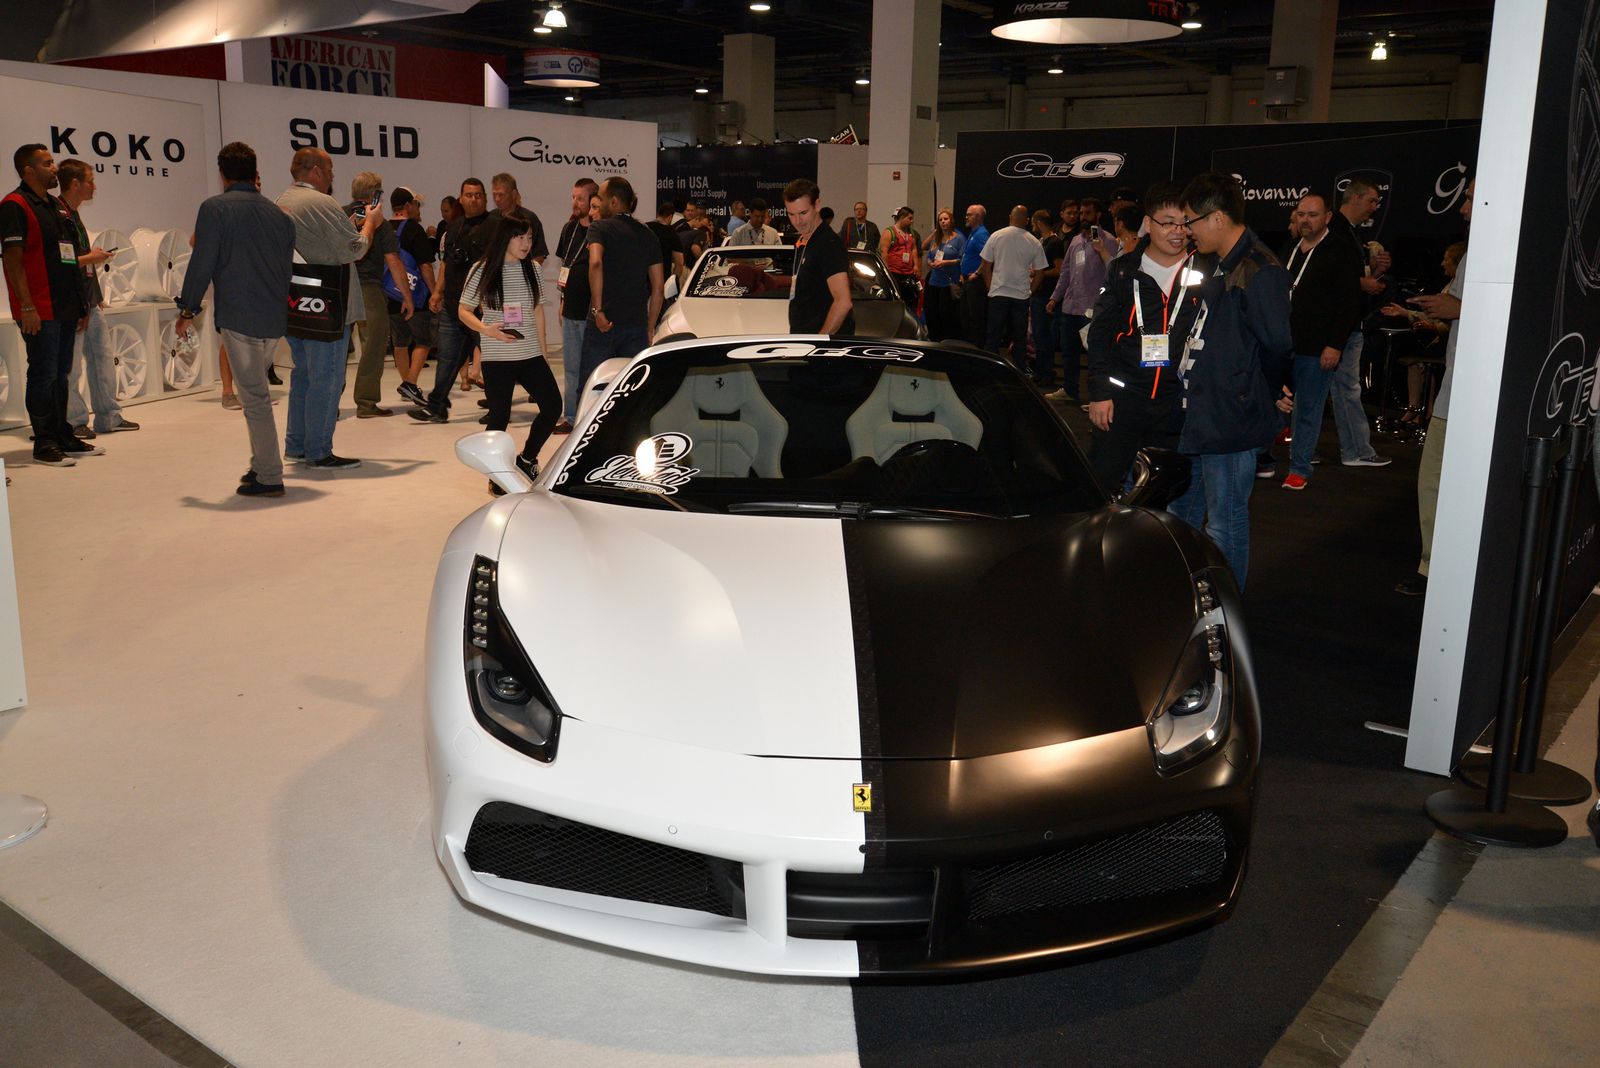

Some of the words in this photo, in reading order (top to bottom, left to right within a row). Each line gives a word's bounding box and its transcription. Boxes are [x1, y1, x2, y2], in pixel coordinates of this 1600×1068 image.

[1013, 1, 1069, 15] KRAZE
[269, 36, 392, 72] AMERICAN
[271, 60, 391, 97] FORCE
[50, 125, 185, 163] KOKO
[508, 136, 628, 168] Giovanna
[95, 163, 169, 177] UTURE
[657, 176, 674, 189] ade
[676, 176, 686, 189] in
[688, 176, 709, 189] USA
[690, 189, 706, 198] Local
[707, 189, 728, 199] Supply
[555, 363, 651, 486] Giovanna
